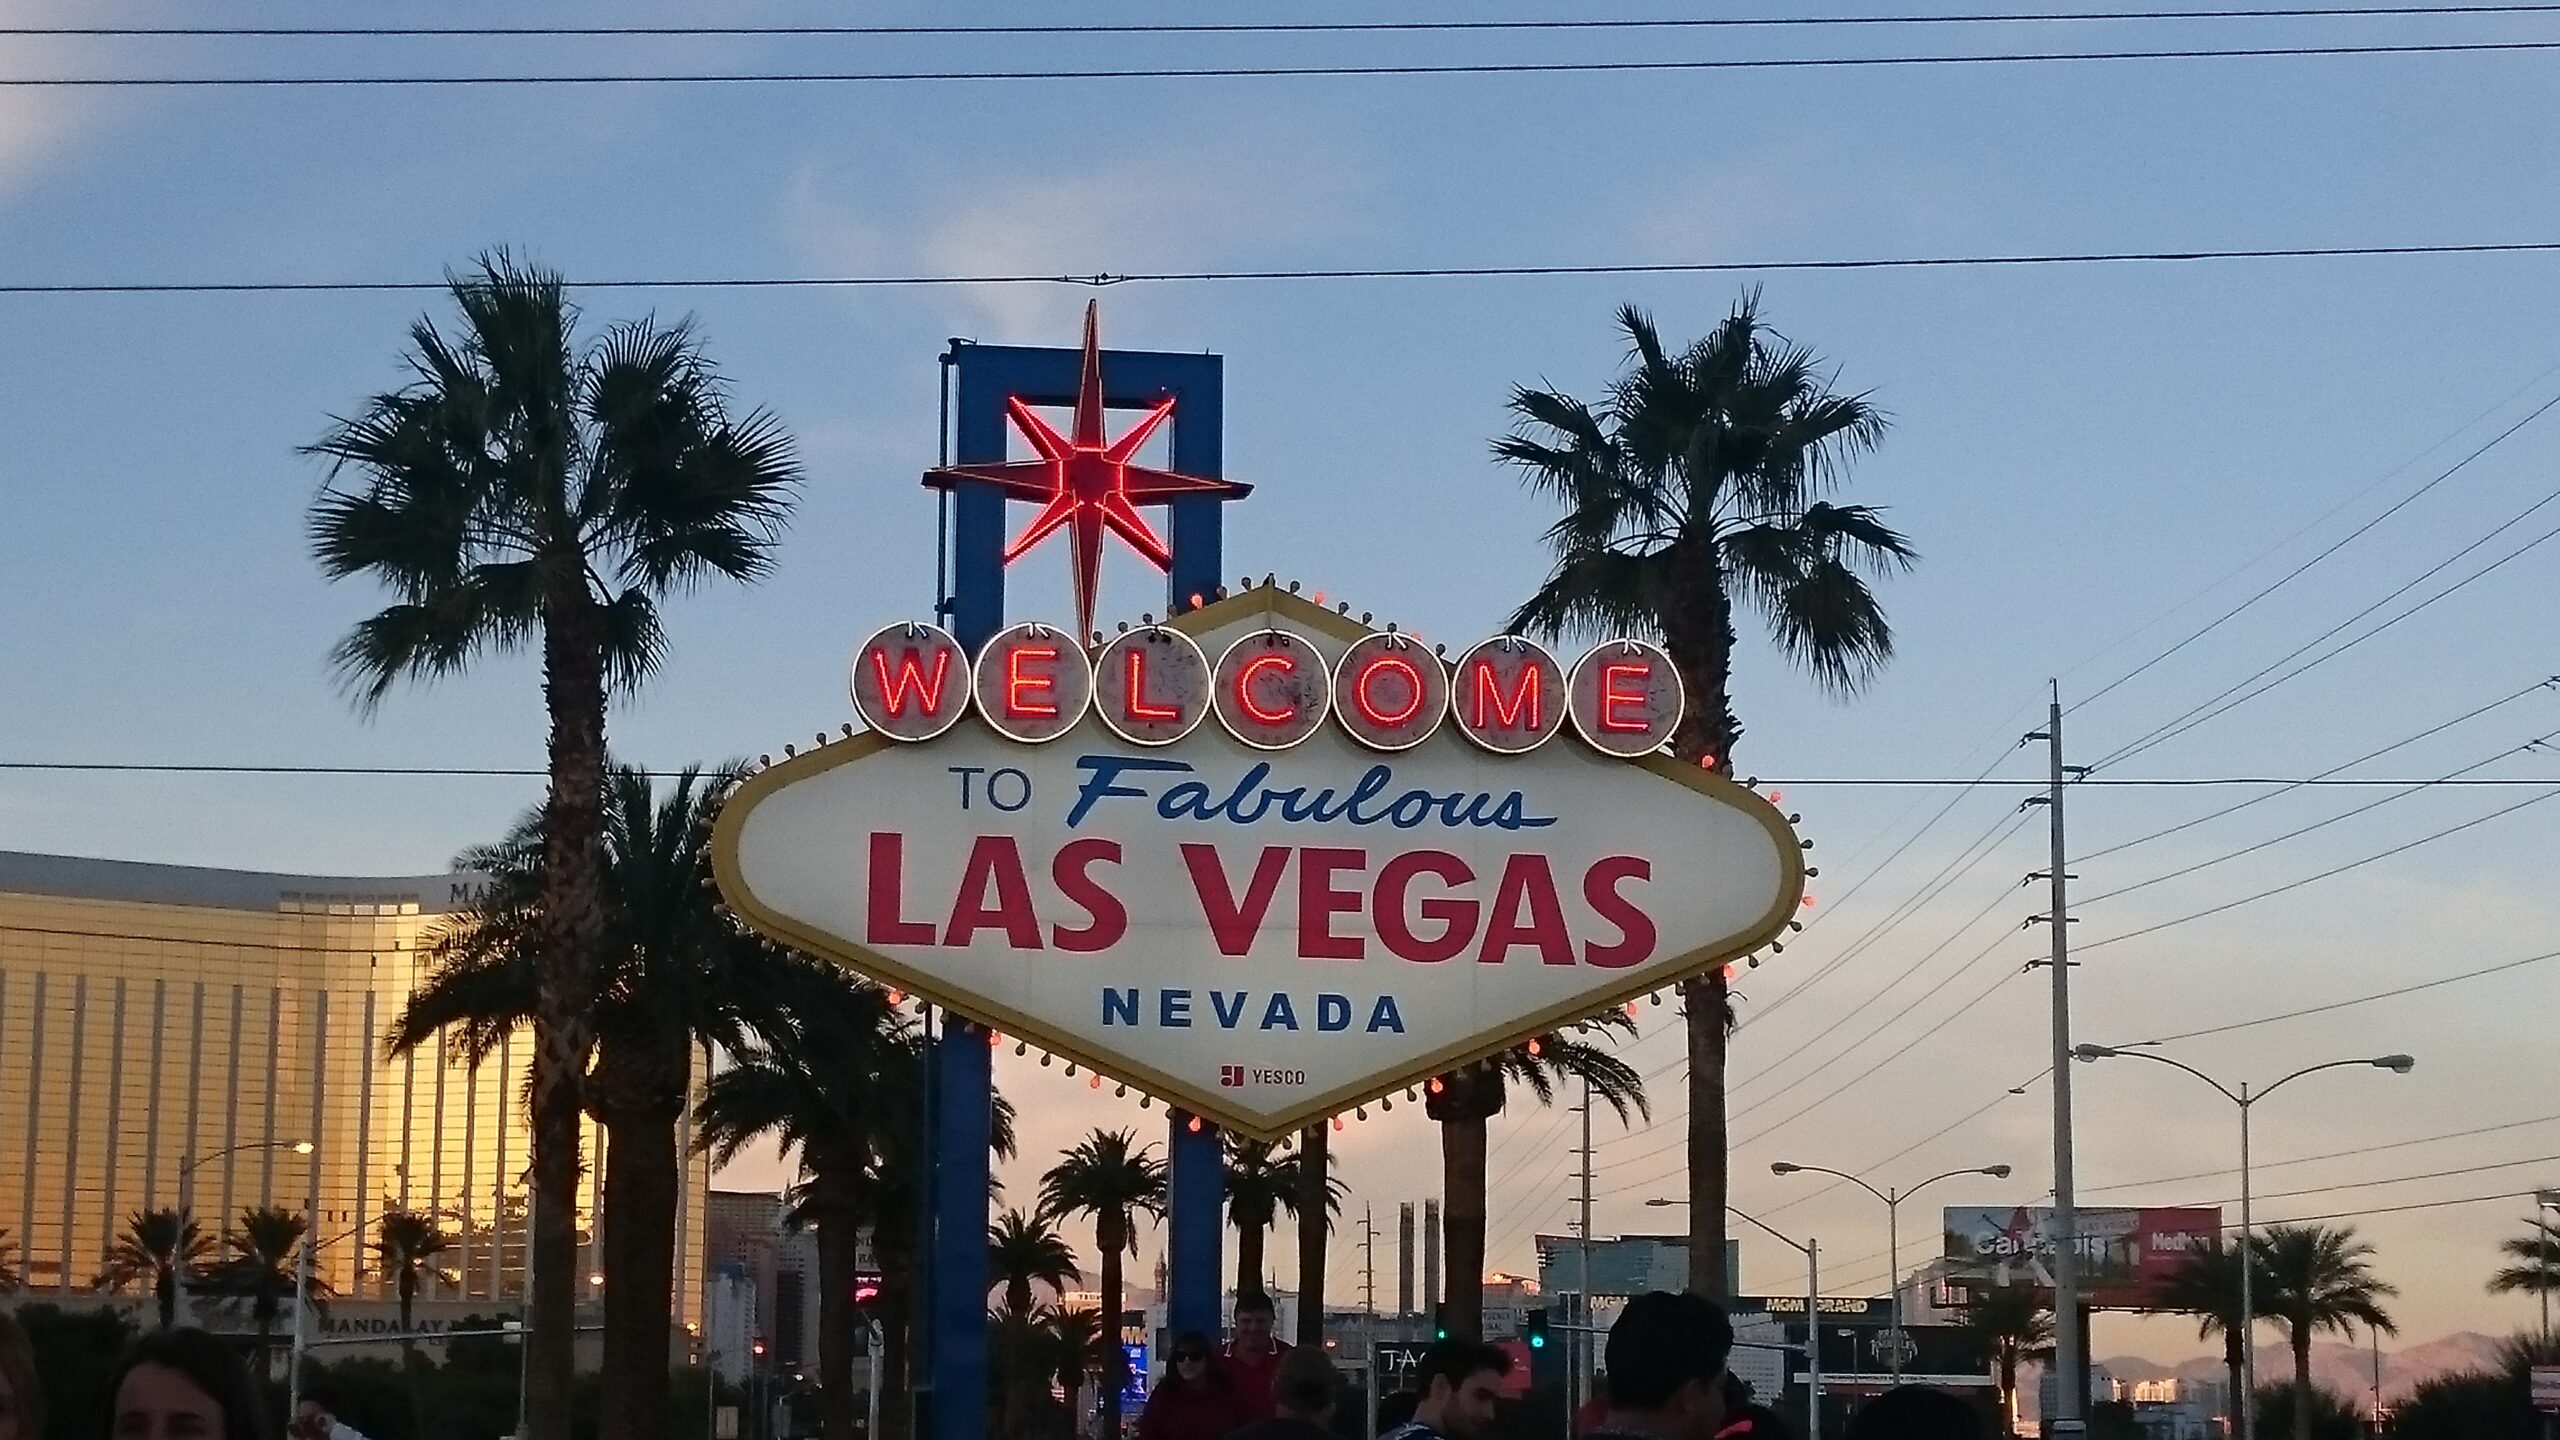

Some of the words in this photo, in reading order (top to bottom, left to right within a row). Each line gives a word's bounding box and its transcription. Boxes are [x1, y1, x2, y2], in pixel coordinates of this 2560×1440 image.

[871, 646, 1651, 734] WELCOME
[949, 766, 1033, 812] TO
[1066, 754, 1559, 830] Fabulous
[867, 832, 1128, 954] LAS
[1180, 844, 1658, 969] VEGAS
[1101, 987, 1406, 1034] NEVADA
[1252, 1068, 1305, 1085] YESCO
[1765, 1298, 1805, 1312] MGM
[1815, 1298, 1869, 1313] GRAND
